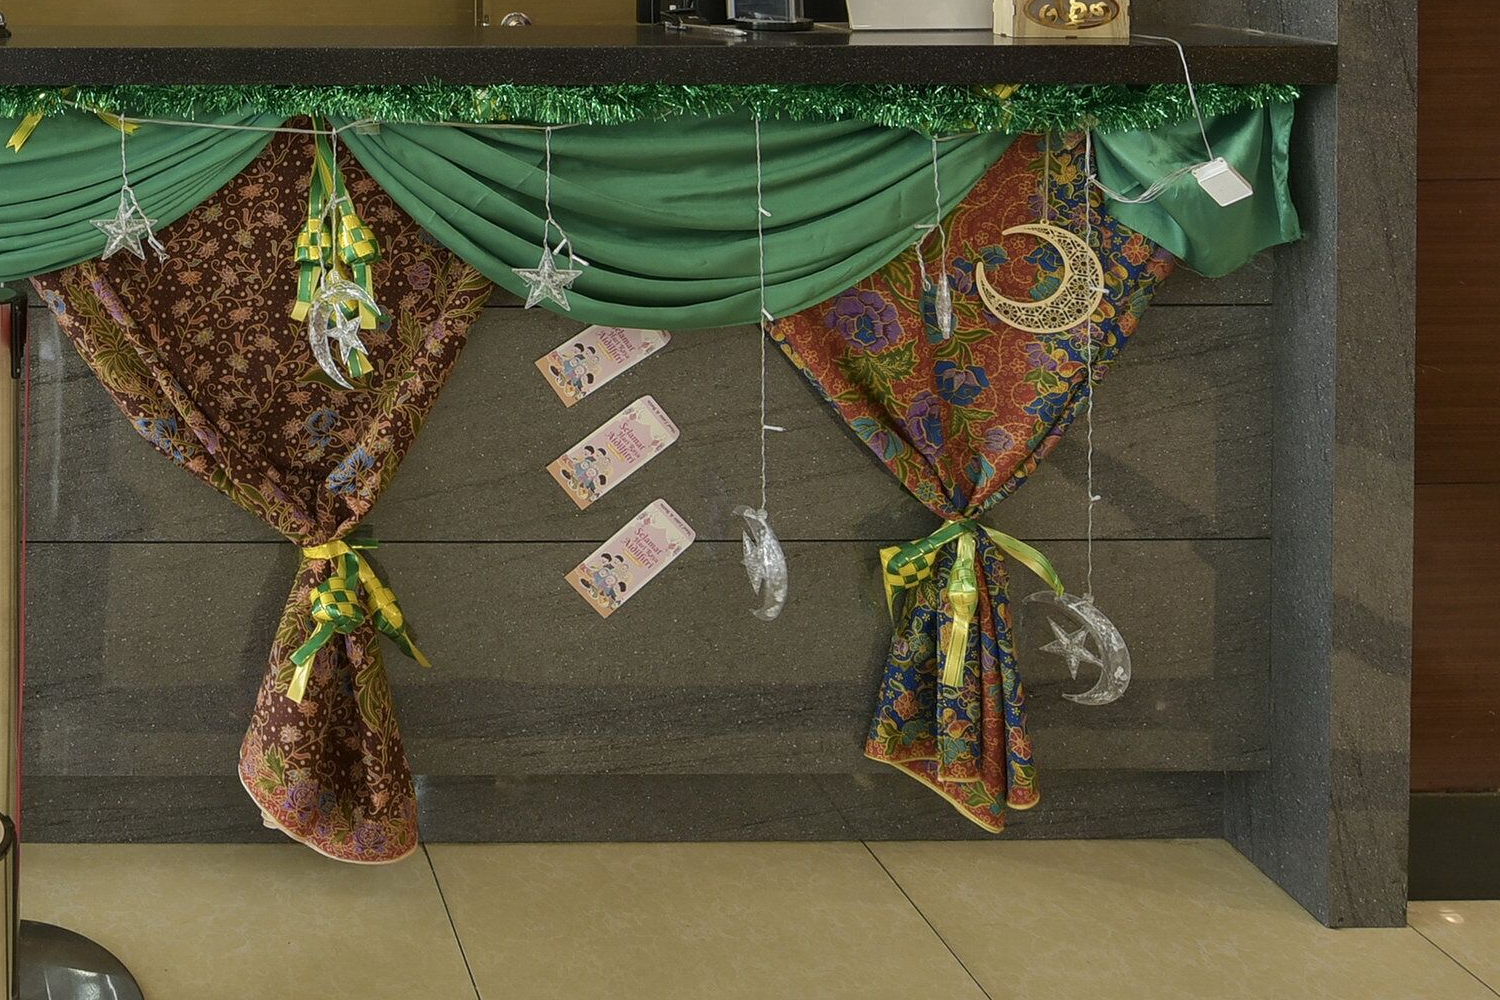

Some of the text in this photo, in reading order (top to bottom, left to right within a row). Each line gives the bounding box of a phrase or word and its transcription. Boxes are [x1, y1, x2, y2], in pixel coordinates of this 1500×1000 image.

[596, 330, 623, 363] Aidilfitri
[615, 328, 635, 351] elamat
[605, 431, 635, 463] Aidilfitri
[620, 423, 645, 450] Selamat
[622, 537, 654, 569] Aidilfitri
[635, 528, 661, 554] Selamat
